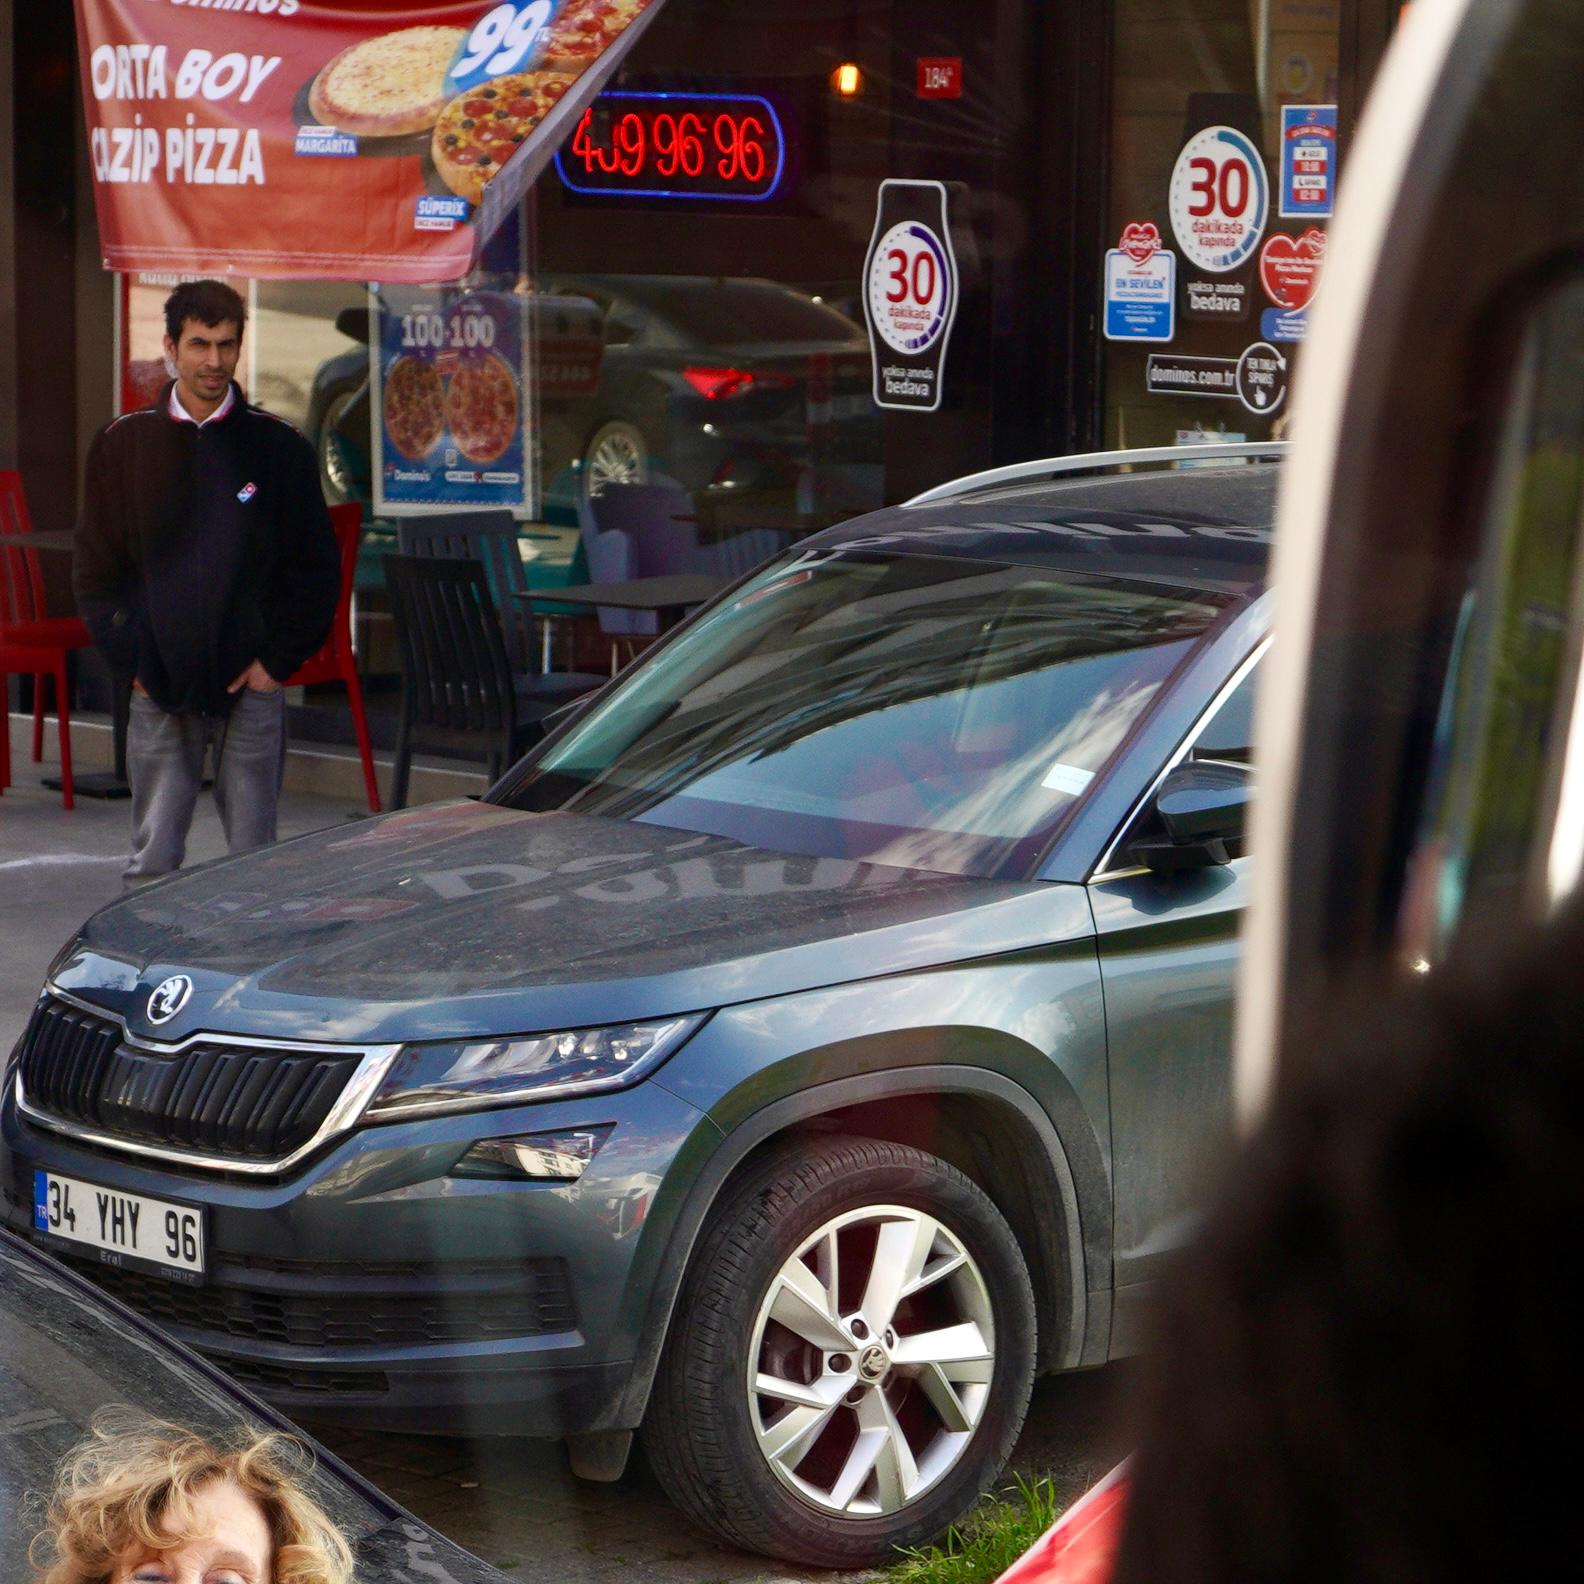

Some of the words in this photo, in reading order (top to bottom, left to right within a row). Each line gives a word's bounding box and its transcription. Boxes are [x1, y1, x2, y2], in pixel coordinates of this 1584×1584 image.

[450, 0, 552, 77] 99
[91, 44, 168, 100] ORTA
[175, 48, 283, 102] BOY
[165, 112, 266, 185] PİZZA
[654, 113, 707, 177] 96
[715, 113, 765, 183] 96
[1188, 157, 1250, 218] 30
[1192, 219, 1244, 235] dakikada
[886, 249, 936, 305] 30
[1190, 293, 1241, 312] bedava
[888, 305, 931, 321] dakikada
[885, 378, 930, 396] bedava
[1150, 364, 1235, 387] dominos.com.tr
[37, 1205, 48, 1219] TR
[48, 1180, 76, 1233] 34
[96, 1192, 140, 1249] YHY
[165, 1210, 196, 1262] 96
